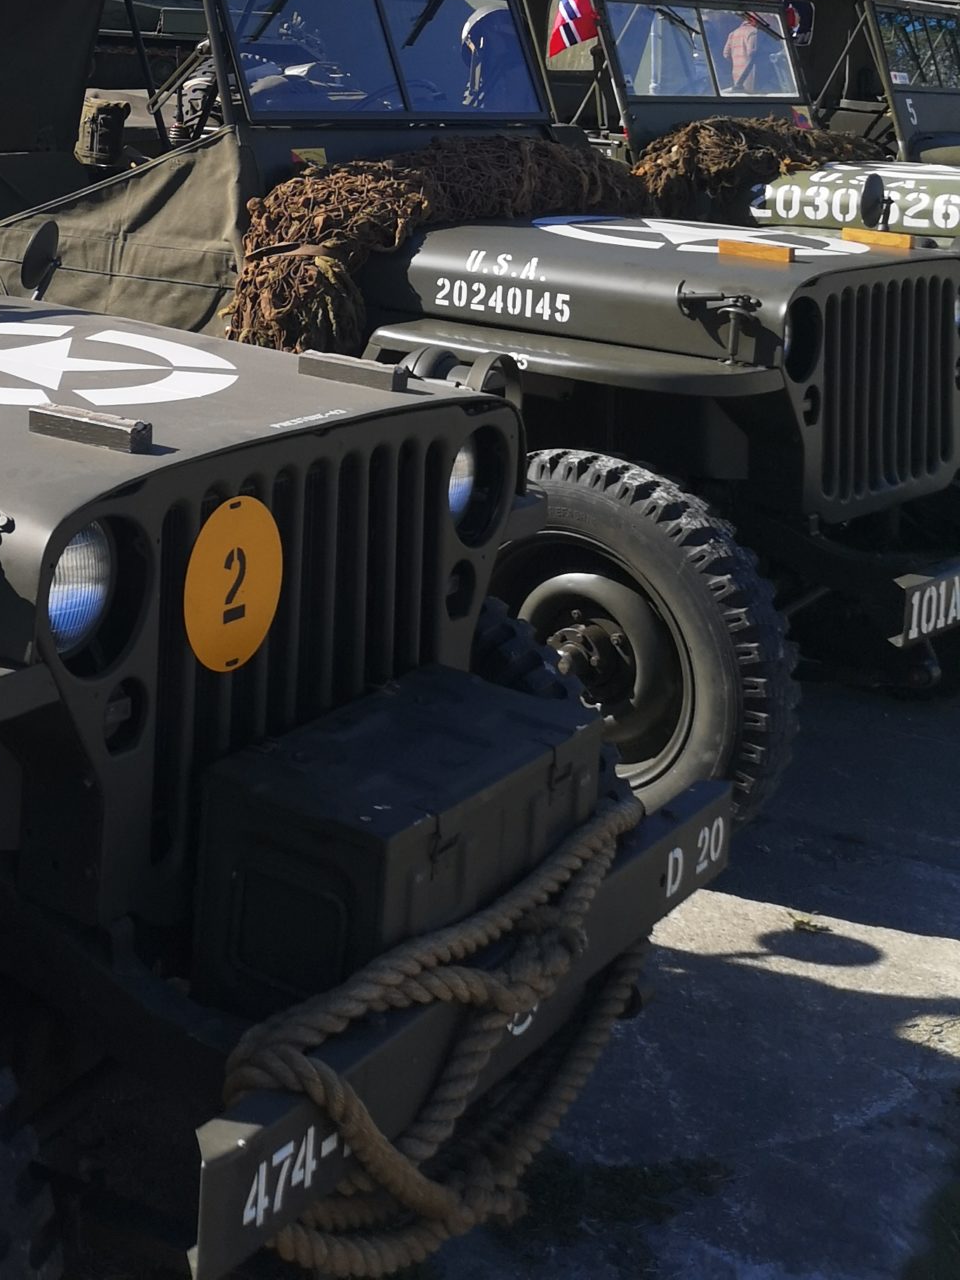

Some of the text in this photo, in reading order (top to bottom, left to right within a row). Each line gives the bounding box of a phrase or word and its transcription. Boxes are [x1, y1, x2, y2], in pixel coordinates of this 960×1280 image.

[906, 99, 917, 125] 5
[809, 171, 928, 190] U.SA.
[749, 183, 960, 229] 2030626
[466, 250, 546, 281] U.S.A.
[435, 277, 571, 323] 20240145
[223, 547, 246, 625] 2
[666, 816, 724, 898] D 20
[242, 1125, 352, 1227] 474-
